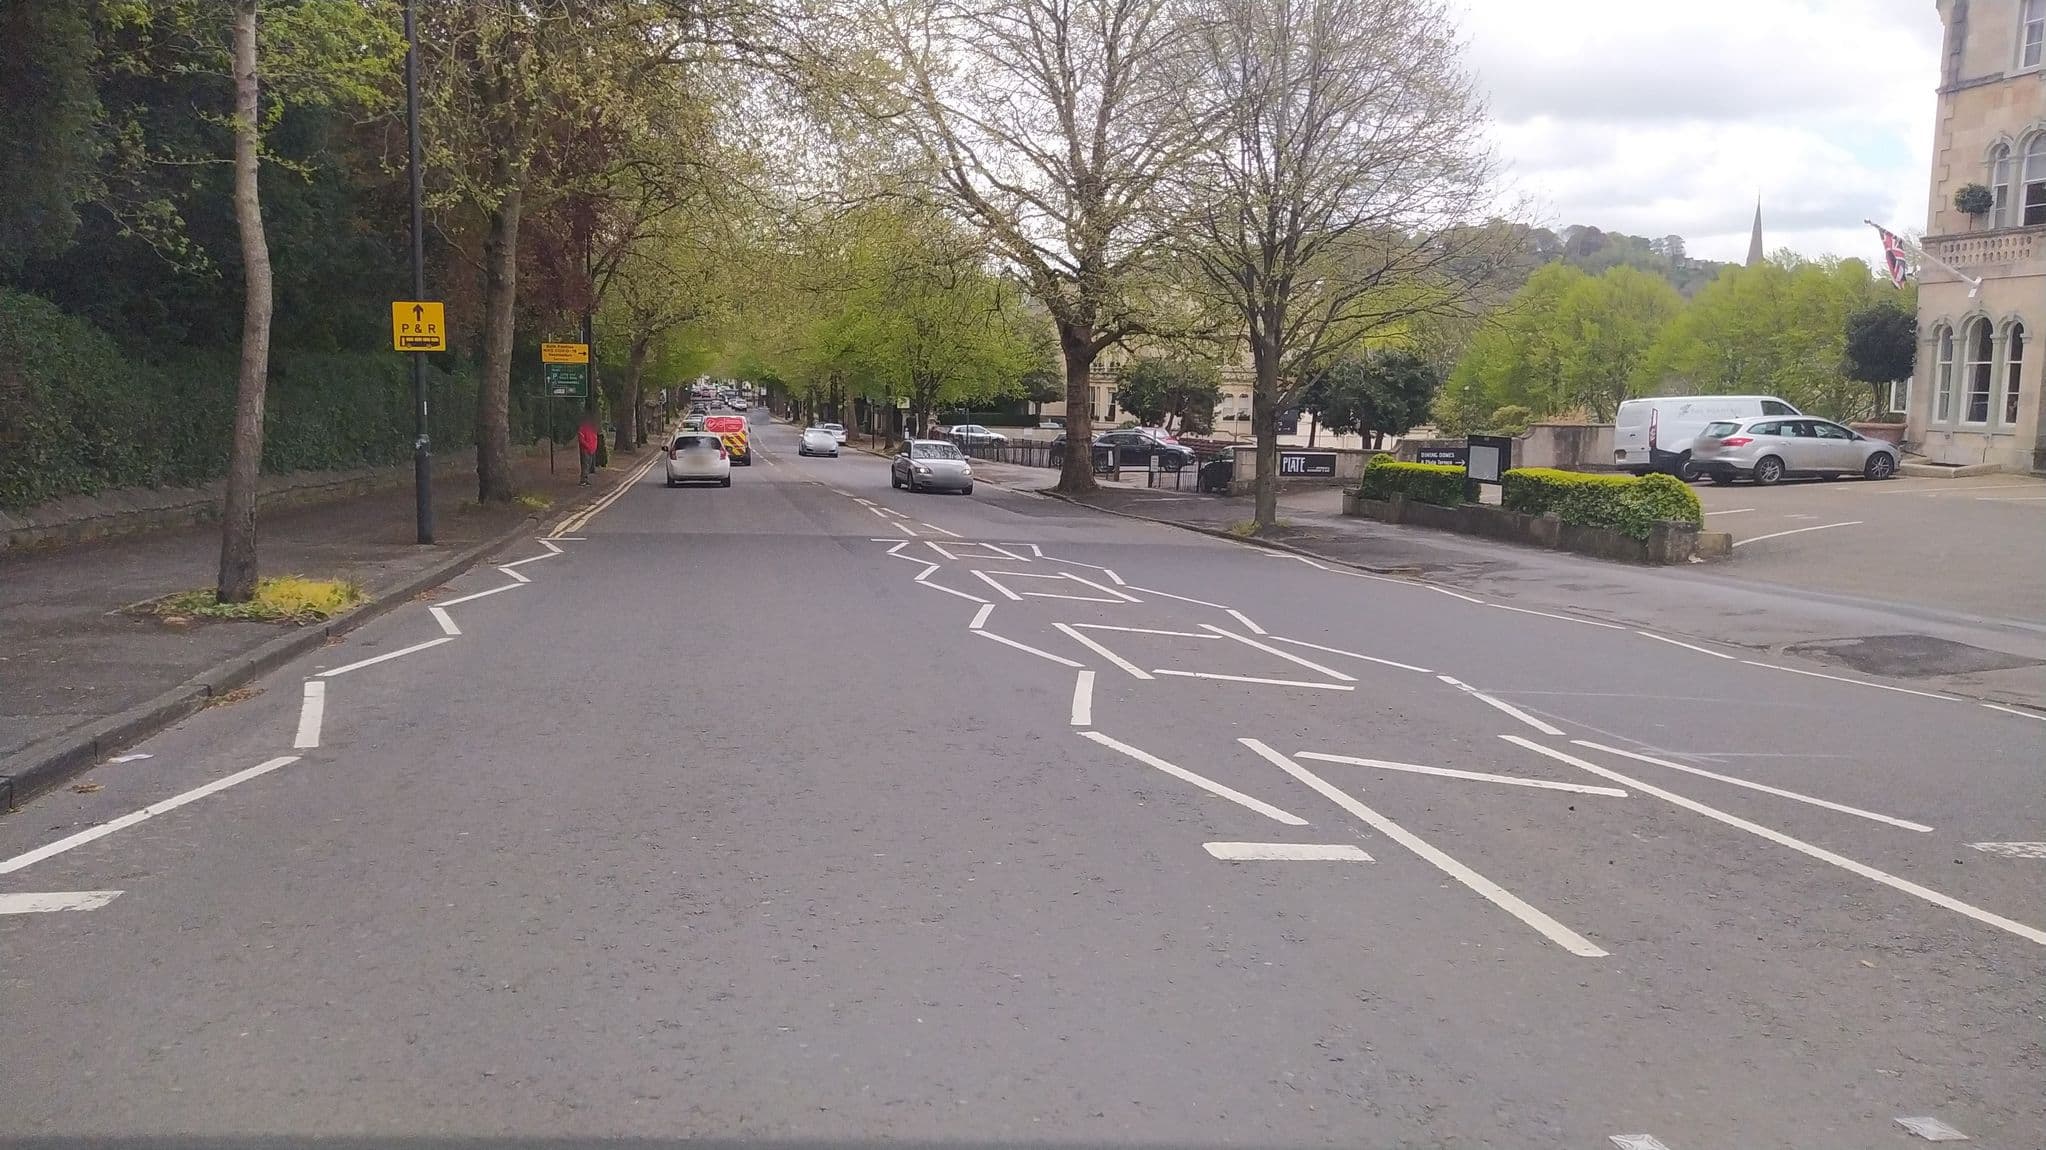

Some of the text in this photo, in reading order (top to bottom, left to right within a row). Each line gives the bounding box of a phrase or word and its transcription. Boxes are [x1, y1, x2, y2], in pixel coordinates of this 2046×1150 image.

[402, 324, 436, 333] P & R
[1282, 456, 1306, 472] PLATE
